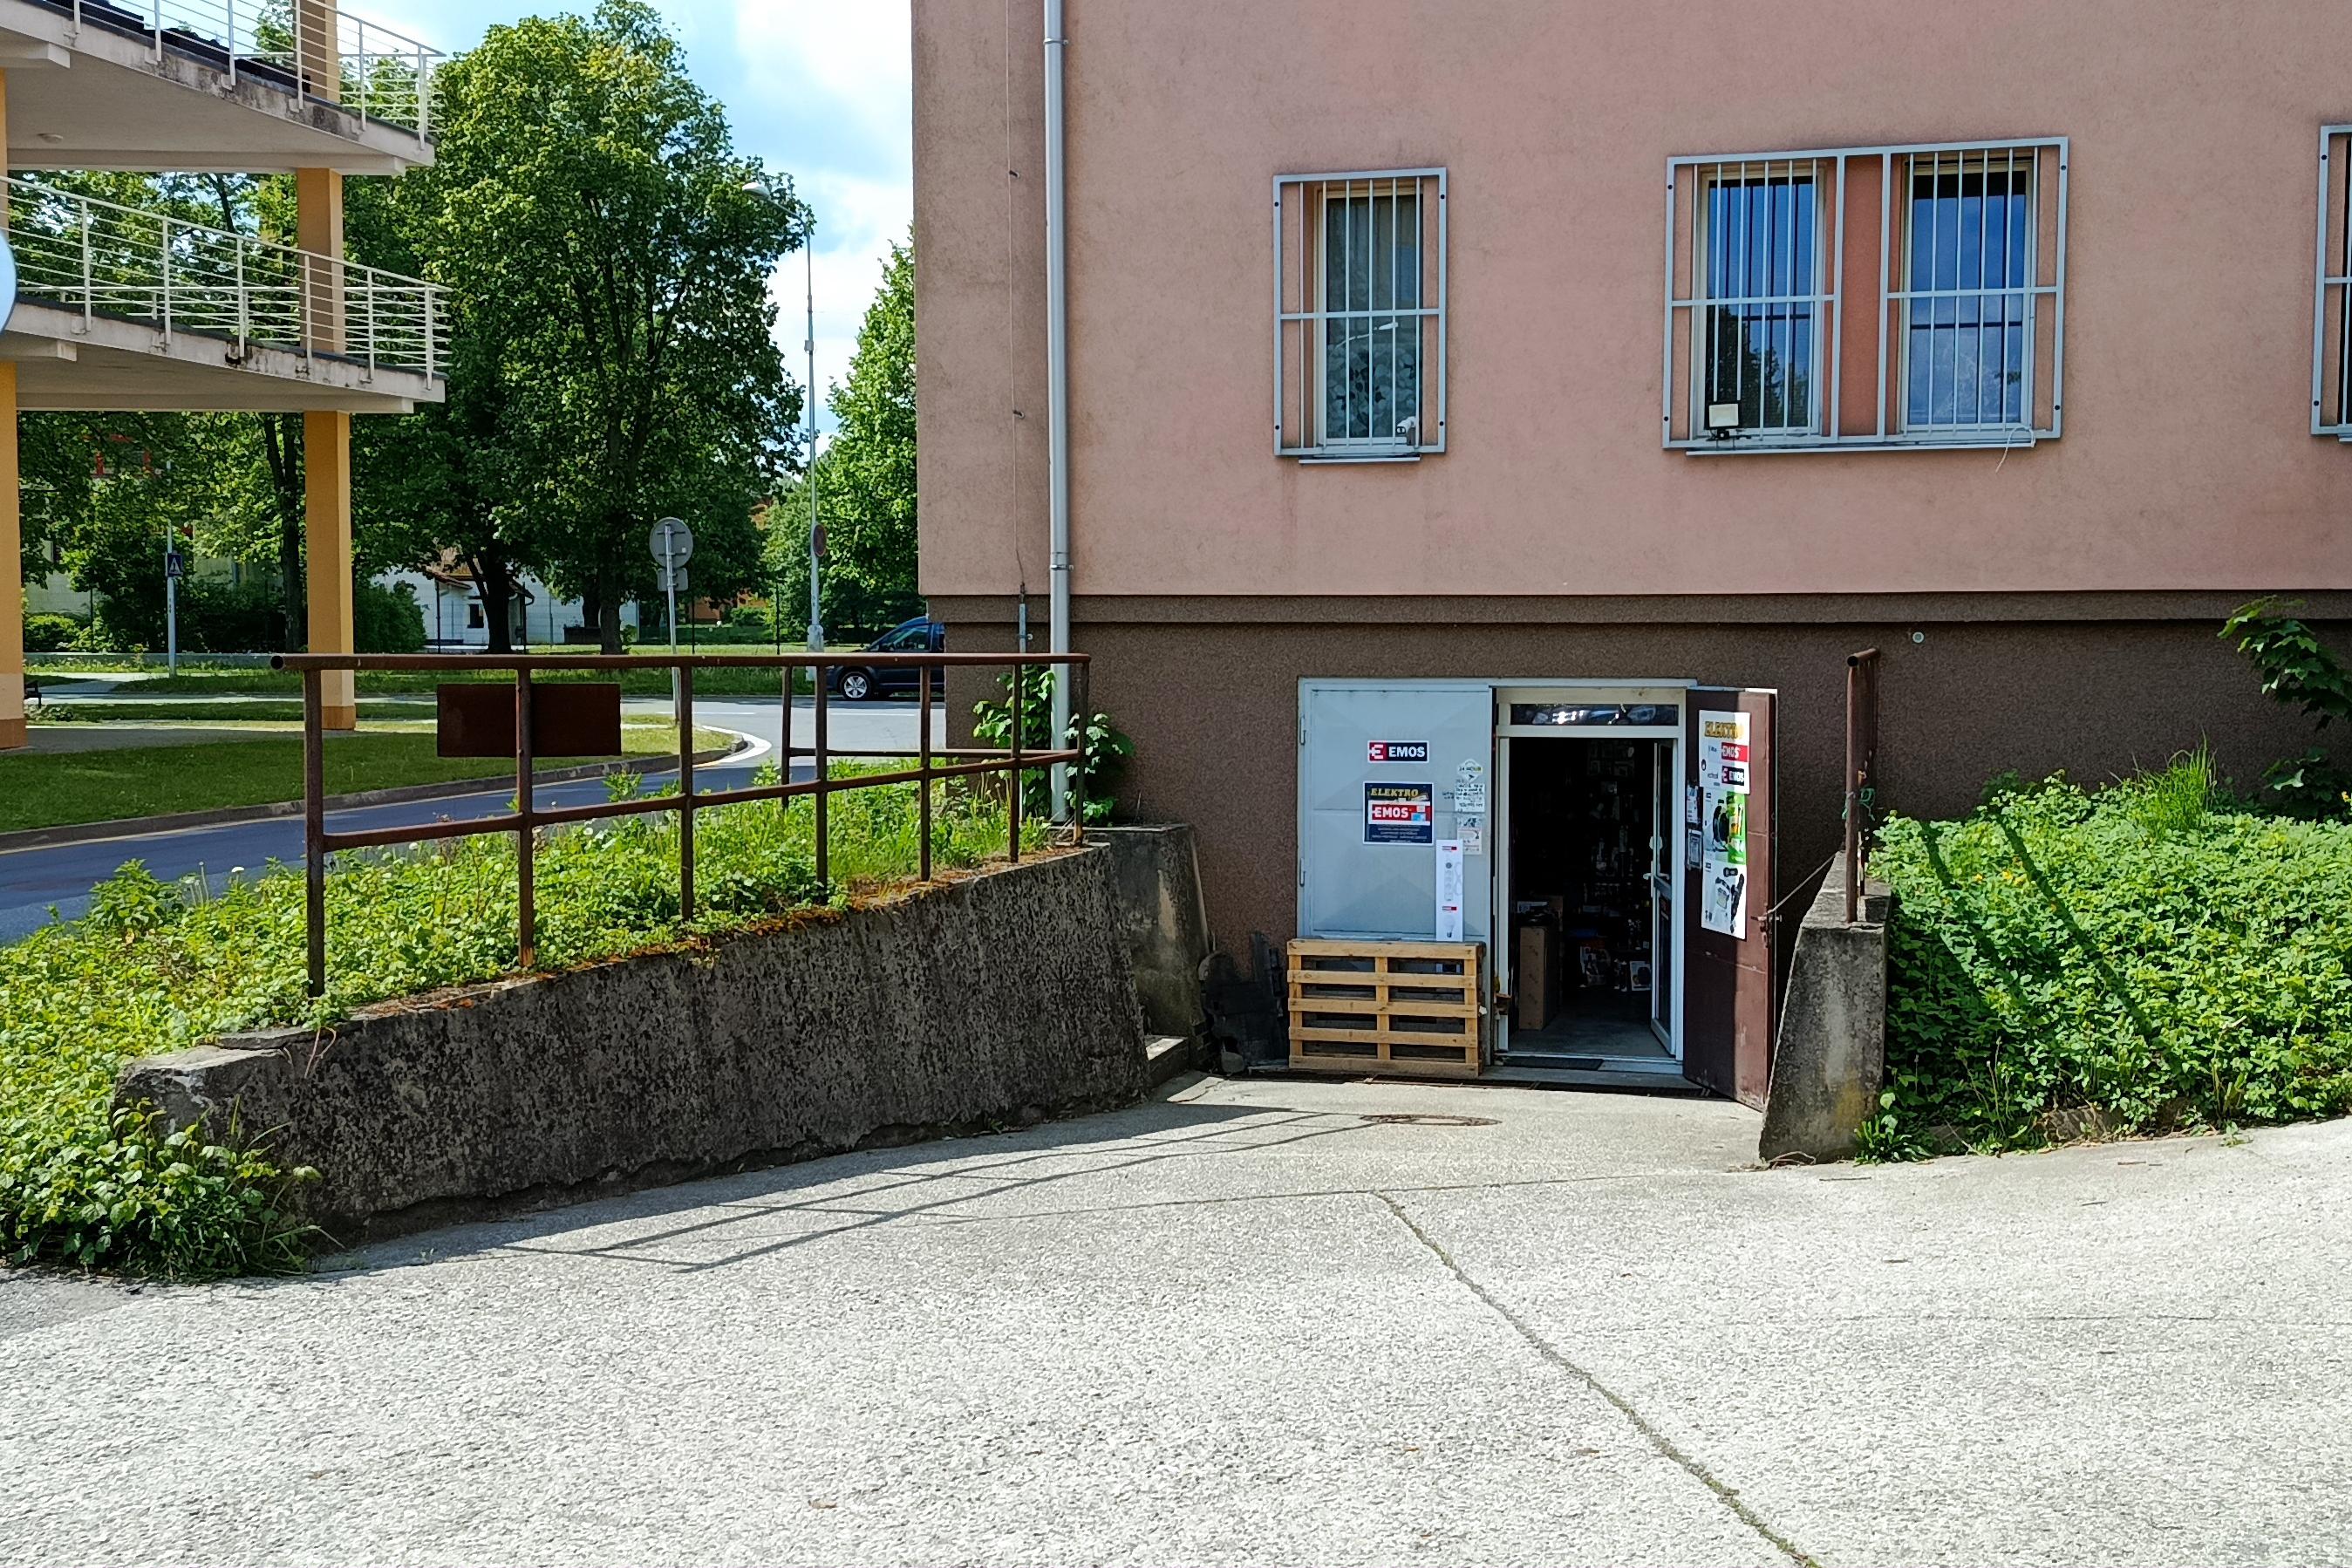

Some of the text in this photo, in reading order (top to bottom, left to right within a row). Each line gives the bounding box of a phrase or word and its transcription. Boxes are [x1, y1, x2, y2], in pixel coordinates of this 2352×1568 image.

[1388, 746, 1426, 758] EMOS
[1370, 787, 1419, 797] ELEKTRO
[1373, 807, 1409, 818] EMOS
